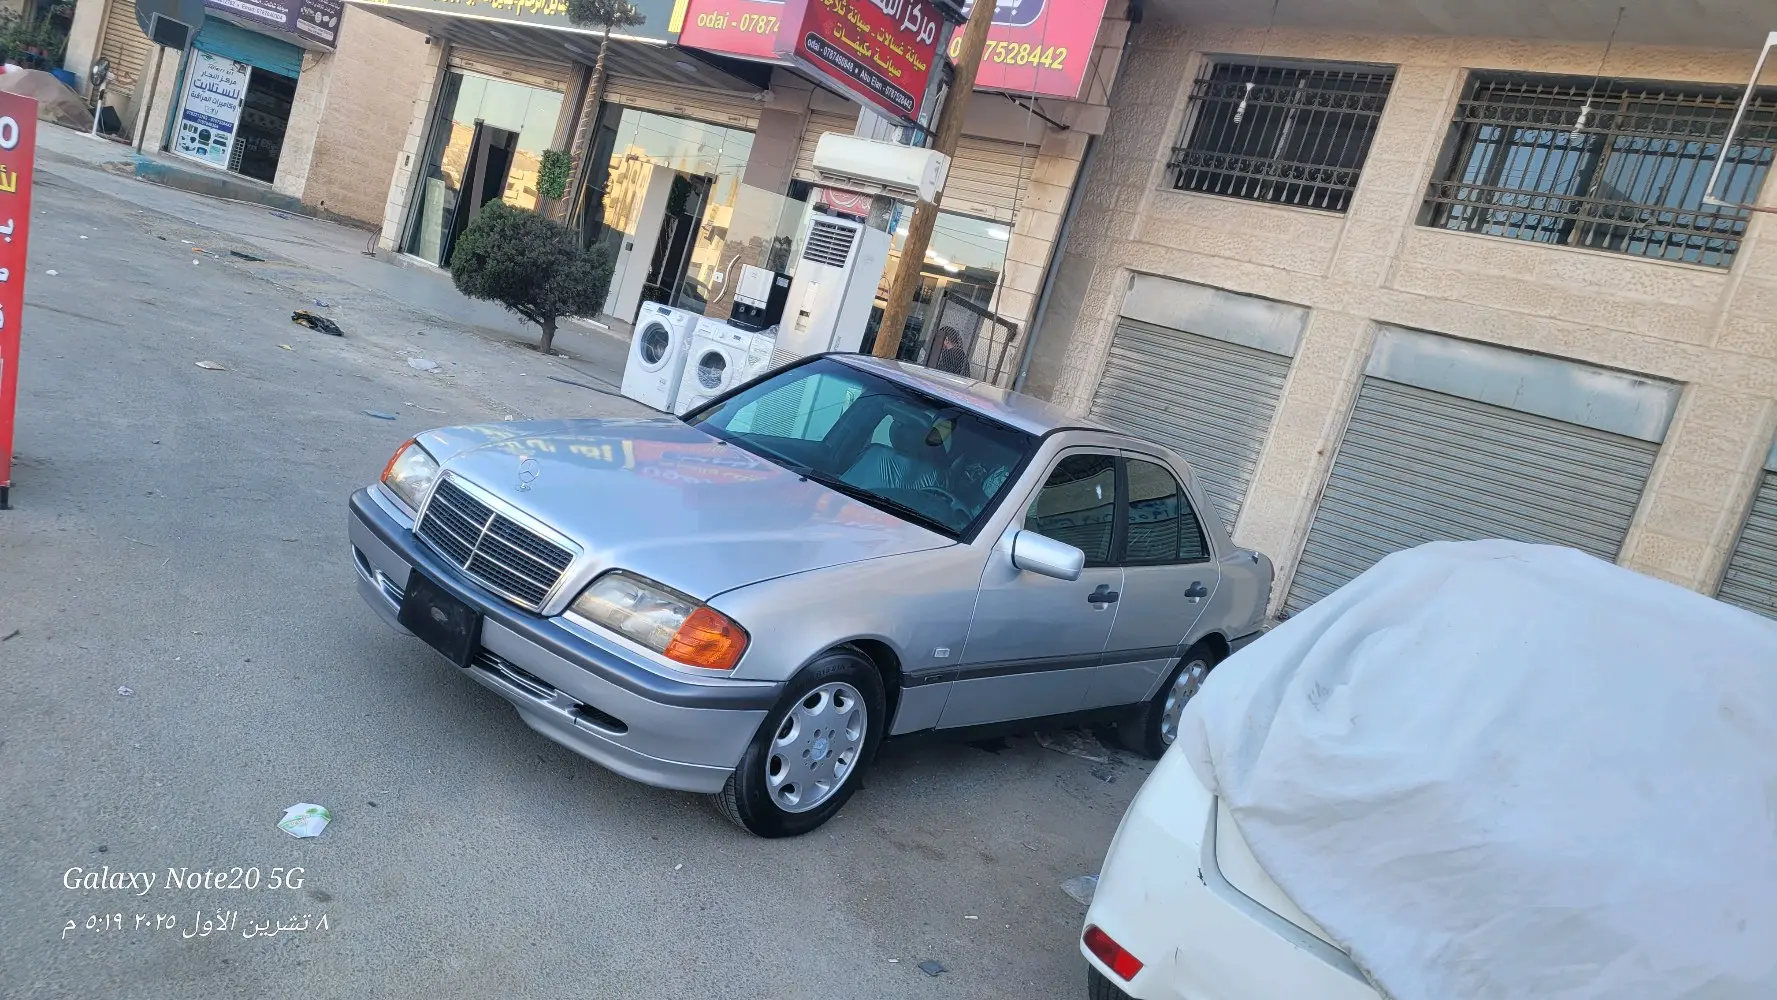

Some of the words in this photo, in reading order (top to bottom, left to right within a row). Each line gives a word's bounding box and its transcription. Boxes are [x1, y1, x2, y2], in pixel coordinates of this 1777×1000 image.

[697, 11, 730, 30] odai
[847, 5, 871, 33] صيانة
[900, 0, 936, 45] مركز
[876, 28, 904, 56] غسالات
[950, 37, 1067, 70] 07528442
[807, 38, 821, 51] odai
[859, 70, 871, 84] Abu
[905, 45, 927, 71] صيانة
[193, 78, 241, 100] للستلايت
[218, 76, 238, 86] مركز
[190, 90, 212, 102] المراقبة
[212, 97, 237, 112] وكاميرات
